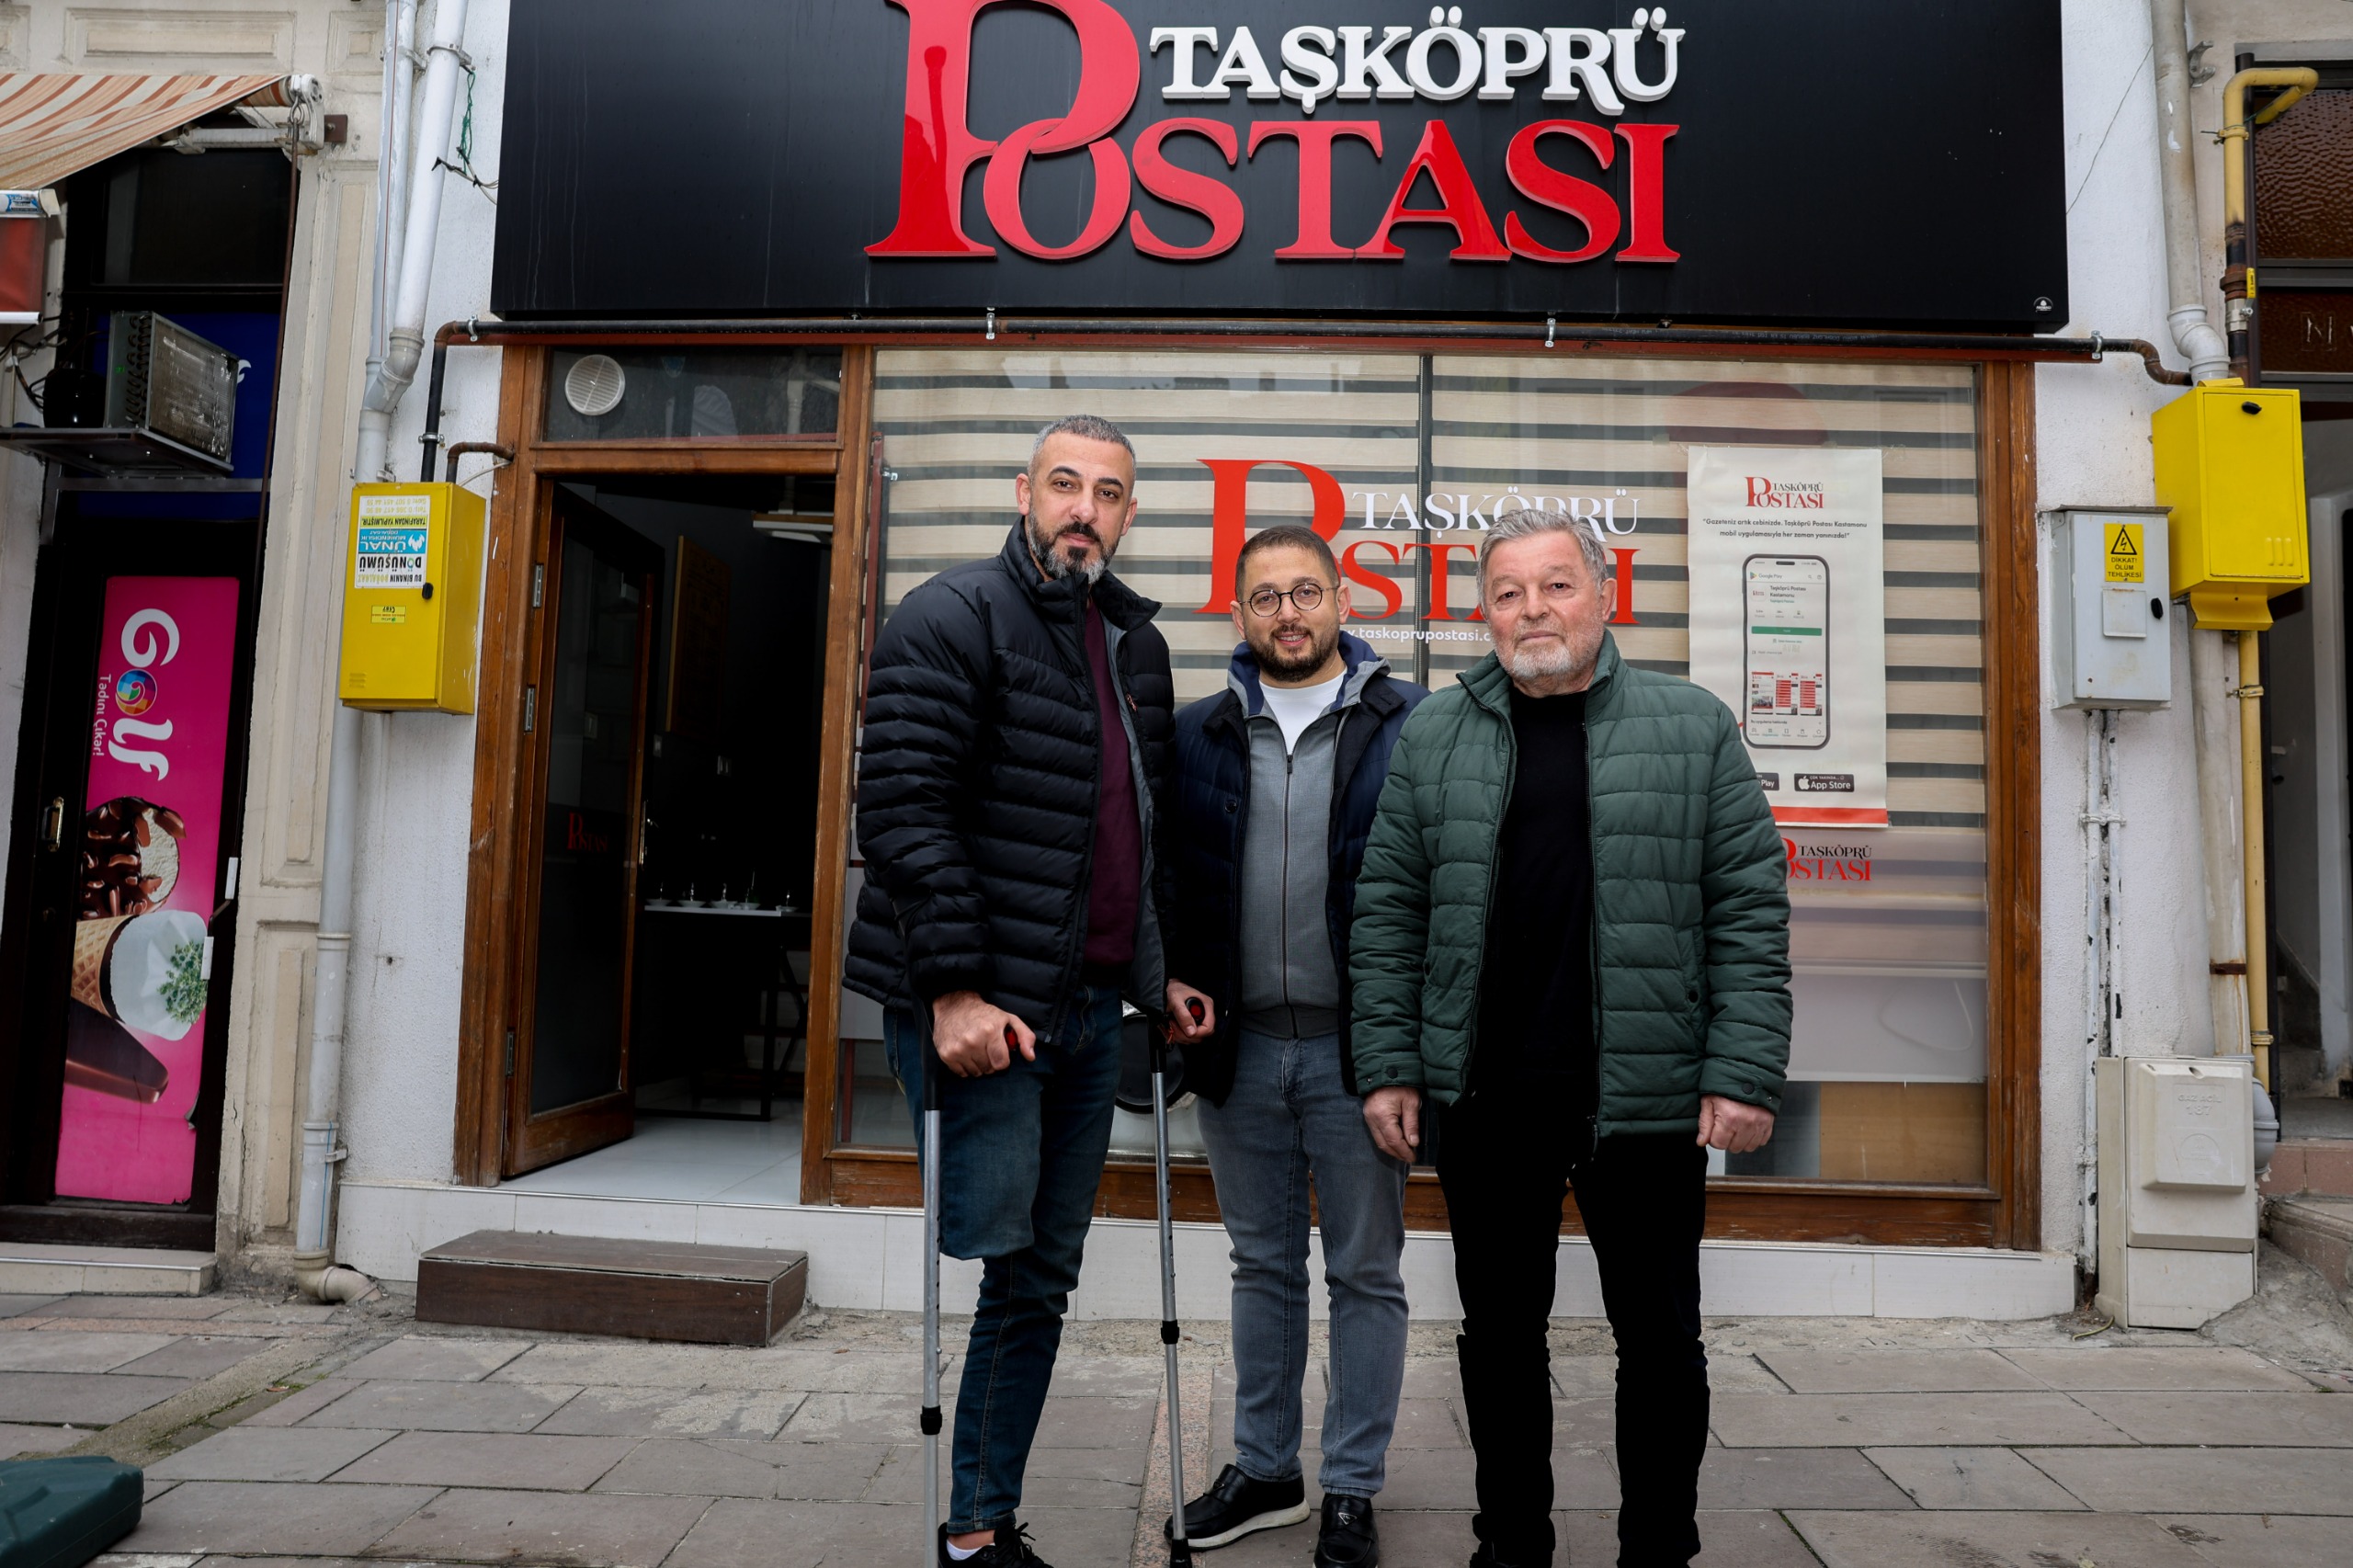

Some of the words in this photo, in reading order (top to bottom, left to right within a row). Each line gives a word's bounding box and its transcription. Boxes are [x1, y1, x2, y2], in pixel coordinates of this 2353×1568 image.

[1149, 6, 1686, 115] TAŞKÖPRÜ
[864, 0, 1680, 264] POSTASI
[1744, 476, 1824, 508] POSTASI
[1771, 482, 1824, 493] TAŞKÖPRÜ
[360, 540, 406, 552] ÜNAL
[1192, 459, 1642, 625] PSTI
[359, 553, 422, 572] DÖNÜŞÜMÜ
[108, 608, 180, 781] Golf
[1761, 779, 1775, 788] Play
[1811, 781, 1828, 790] App
[1829, 781, 1851, 790] Store
[1799, 845, 1871, 859] TAŞKÖPRÜ
